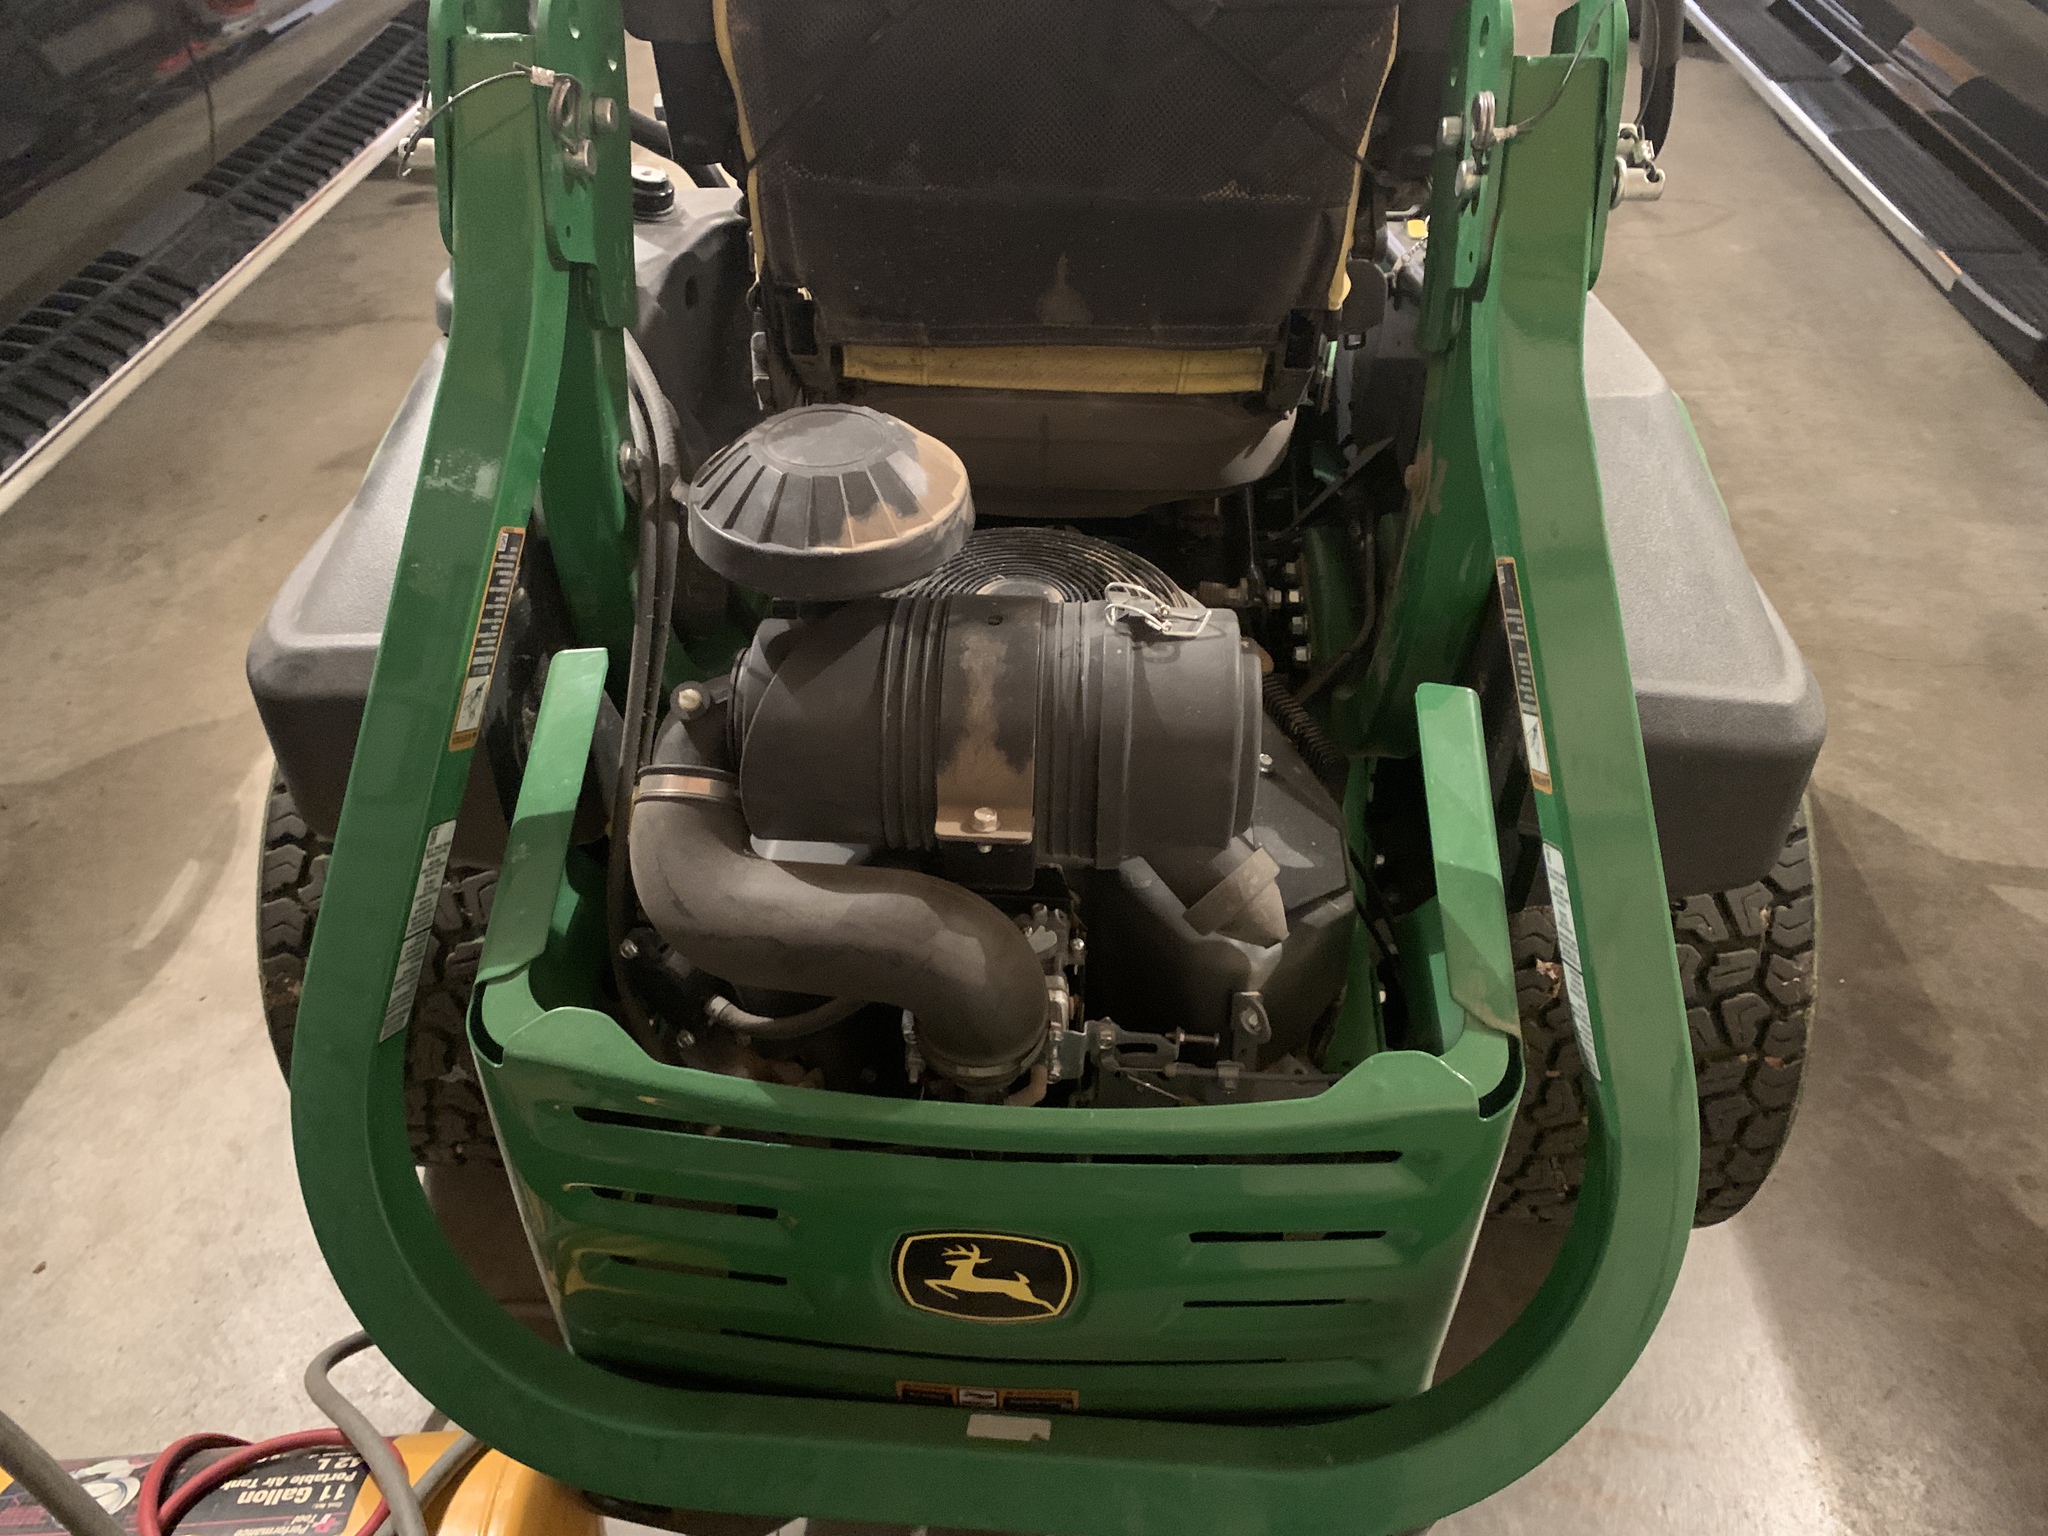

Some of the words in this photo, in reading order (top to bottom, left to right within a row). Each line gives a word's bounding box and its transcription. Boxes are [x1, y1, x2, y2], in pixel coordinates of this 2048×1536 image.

[317, 1458, 333, 1471] L
[219, 1478, 259, 1490] Tank
[262, 1476, 288, 1487] Air
[290, 1470, 358, 1486] Portable
[236, 1486, 313, 1506] Gallon
[318, 1484, 346, 1502] 11
[290, 1513, 318, 1525] Tool
